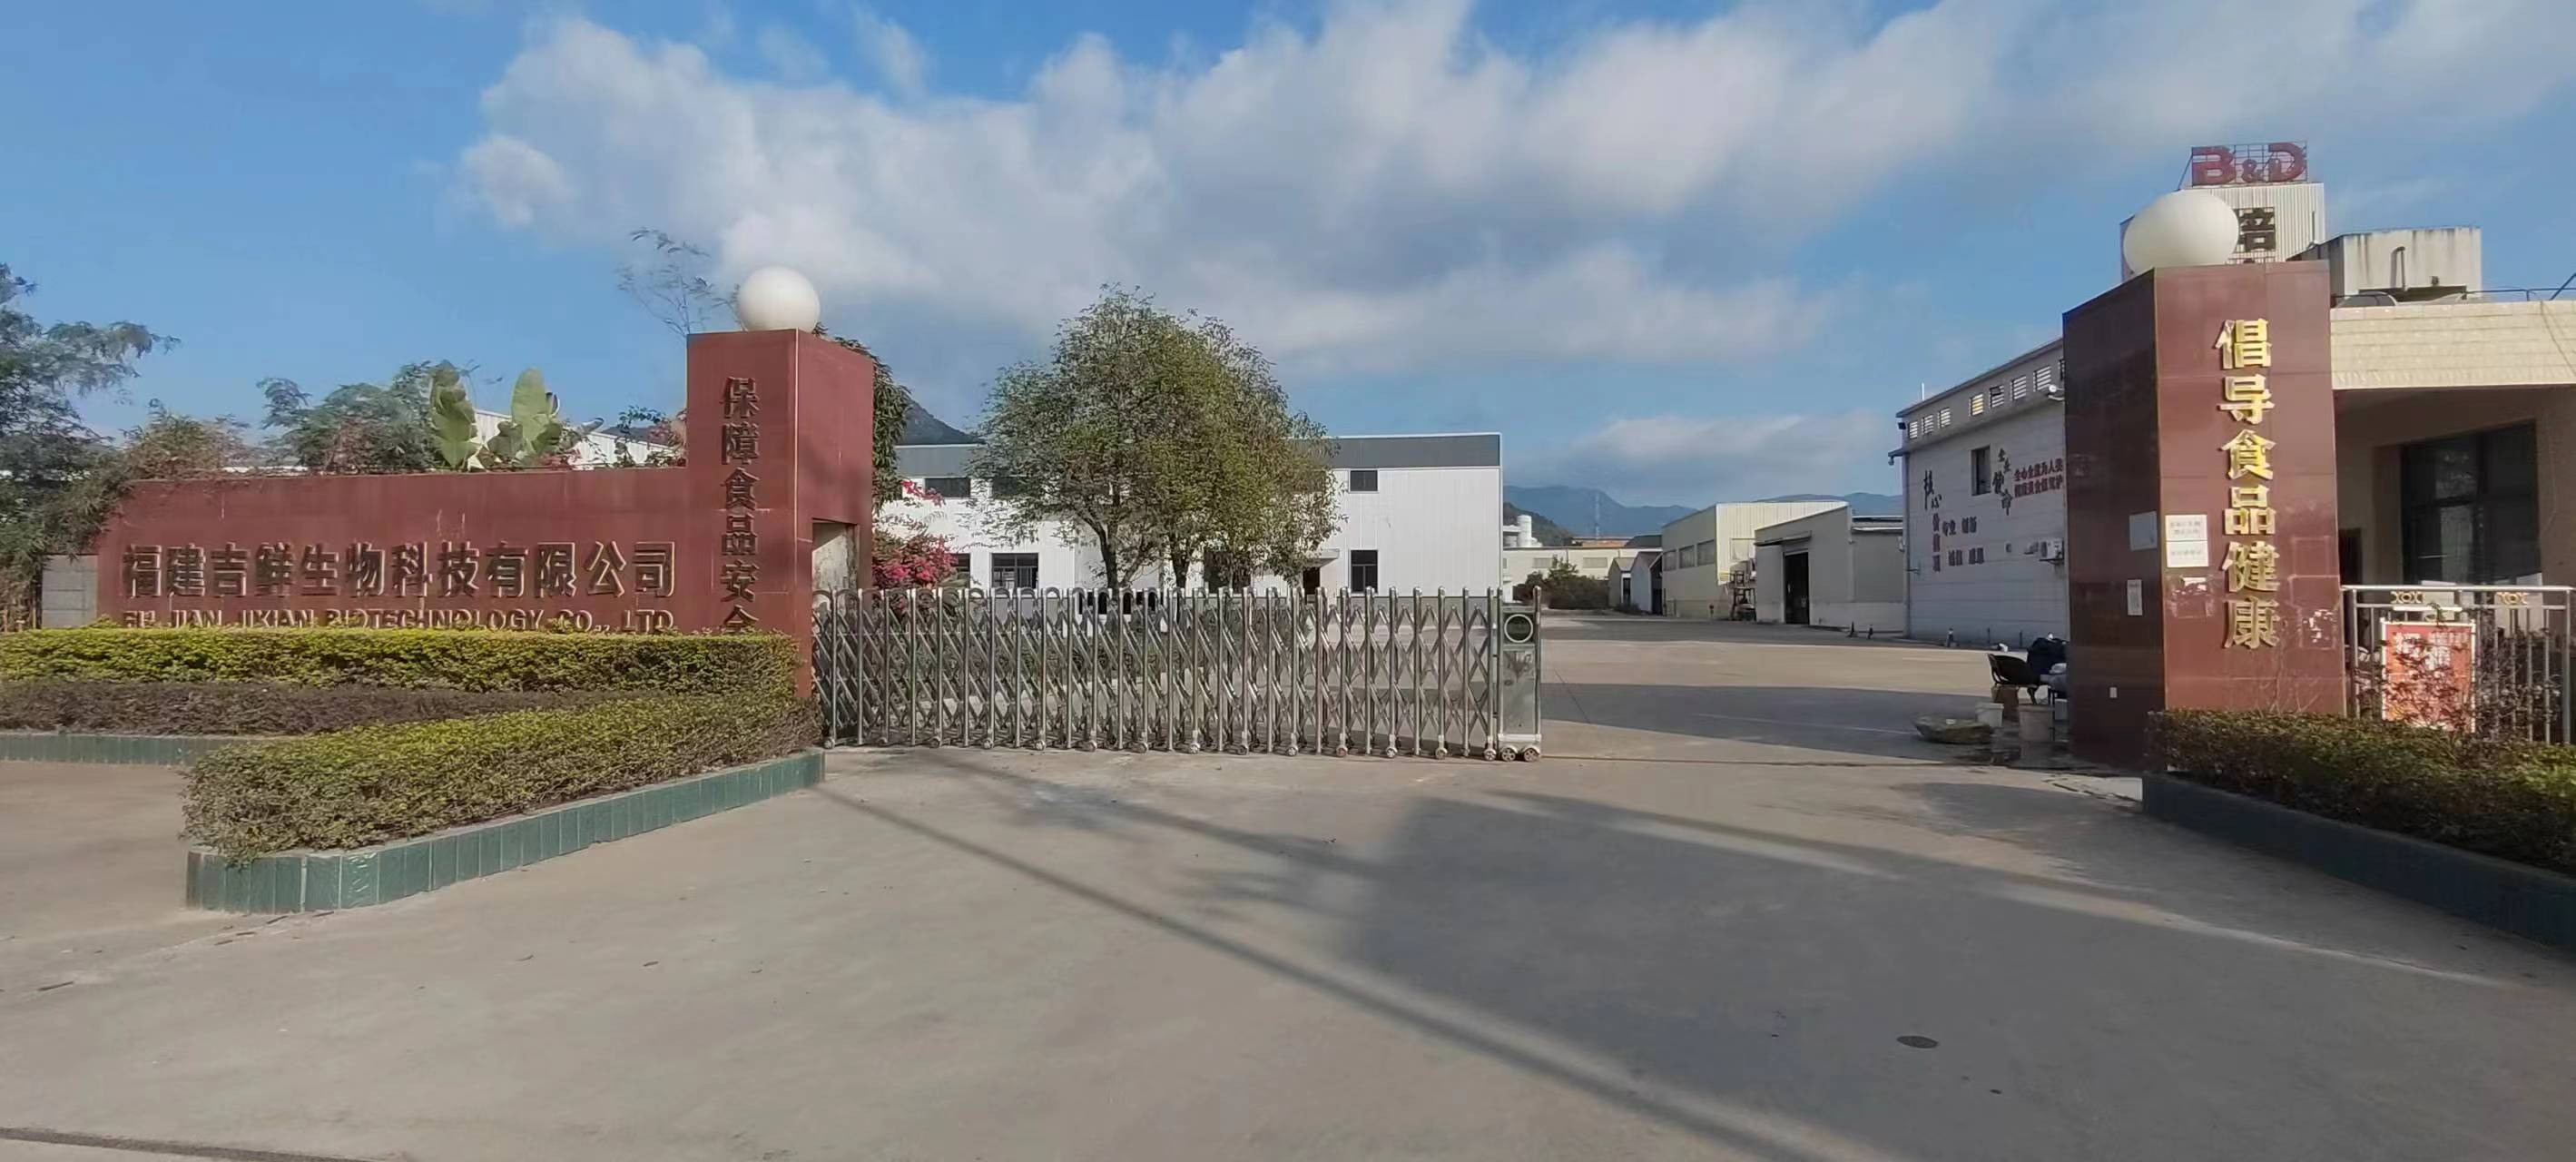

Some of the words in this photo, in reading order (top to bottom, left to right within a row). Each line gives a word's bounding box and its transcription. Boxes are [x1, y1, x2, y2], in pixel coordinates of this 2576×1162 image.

[2191, 142, 2306, 187] B&D
[720, 376, 761, 632] 保障食品安全
[2215, 318, 2279, 649] 倡导食品健康
[123, 541, 675, 598] 福建吉鲜生物科技有限公司
[171, 609, 222, 629] JIAN
